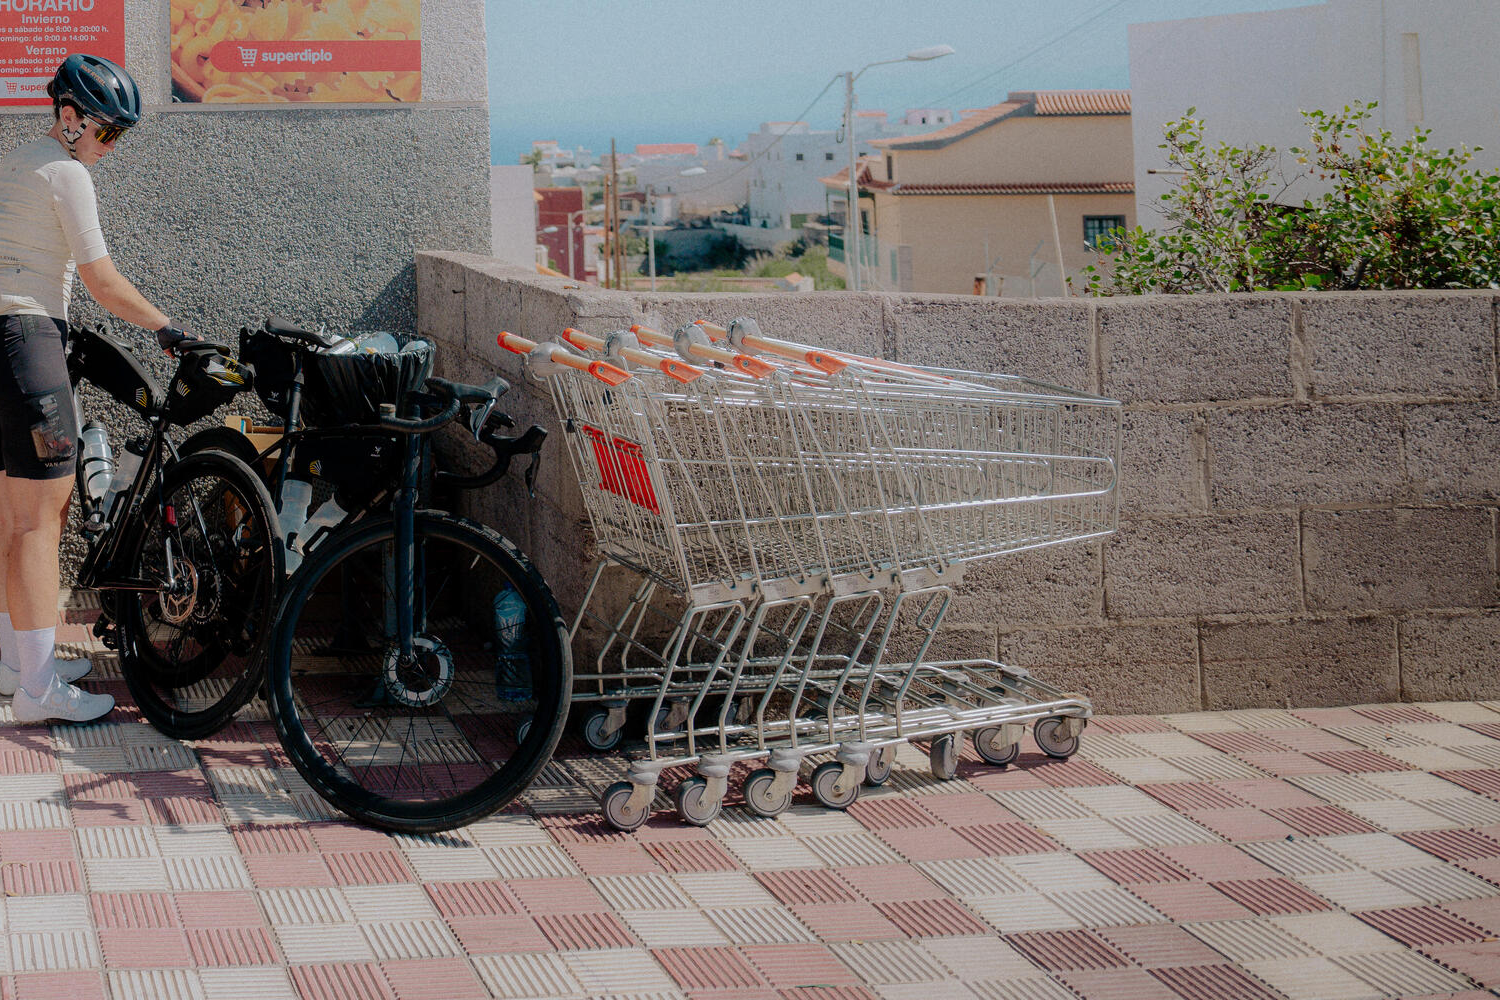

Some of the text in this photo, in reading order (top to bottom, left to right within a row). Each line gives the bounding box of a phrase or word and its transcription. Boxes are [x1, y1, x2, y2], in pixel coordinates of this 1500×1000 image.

[21, 14, 70, 24] Invierno
[14, 25, 43, 33] sábado
[25, 45, 68, 55] Verano
[14, 56, 43, 65] sábado
[261, 48, 333, 65] superdiplo
